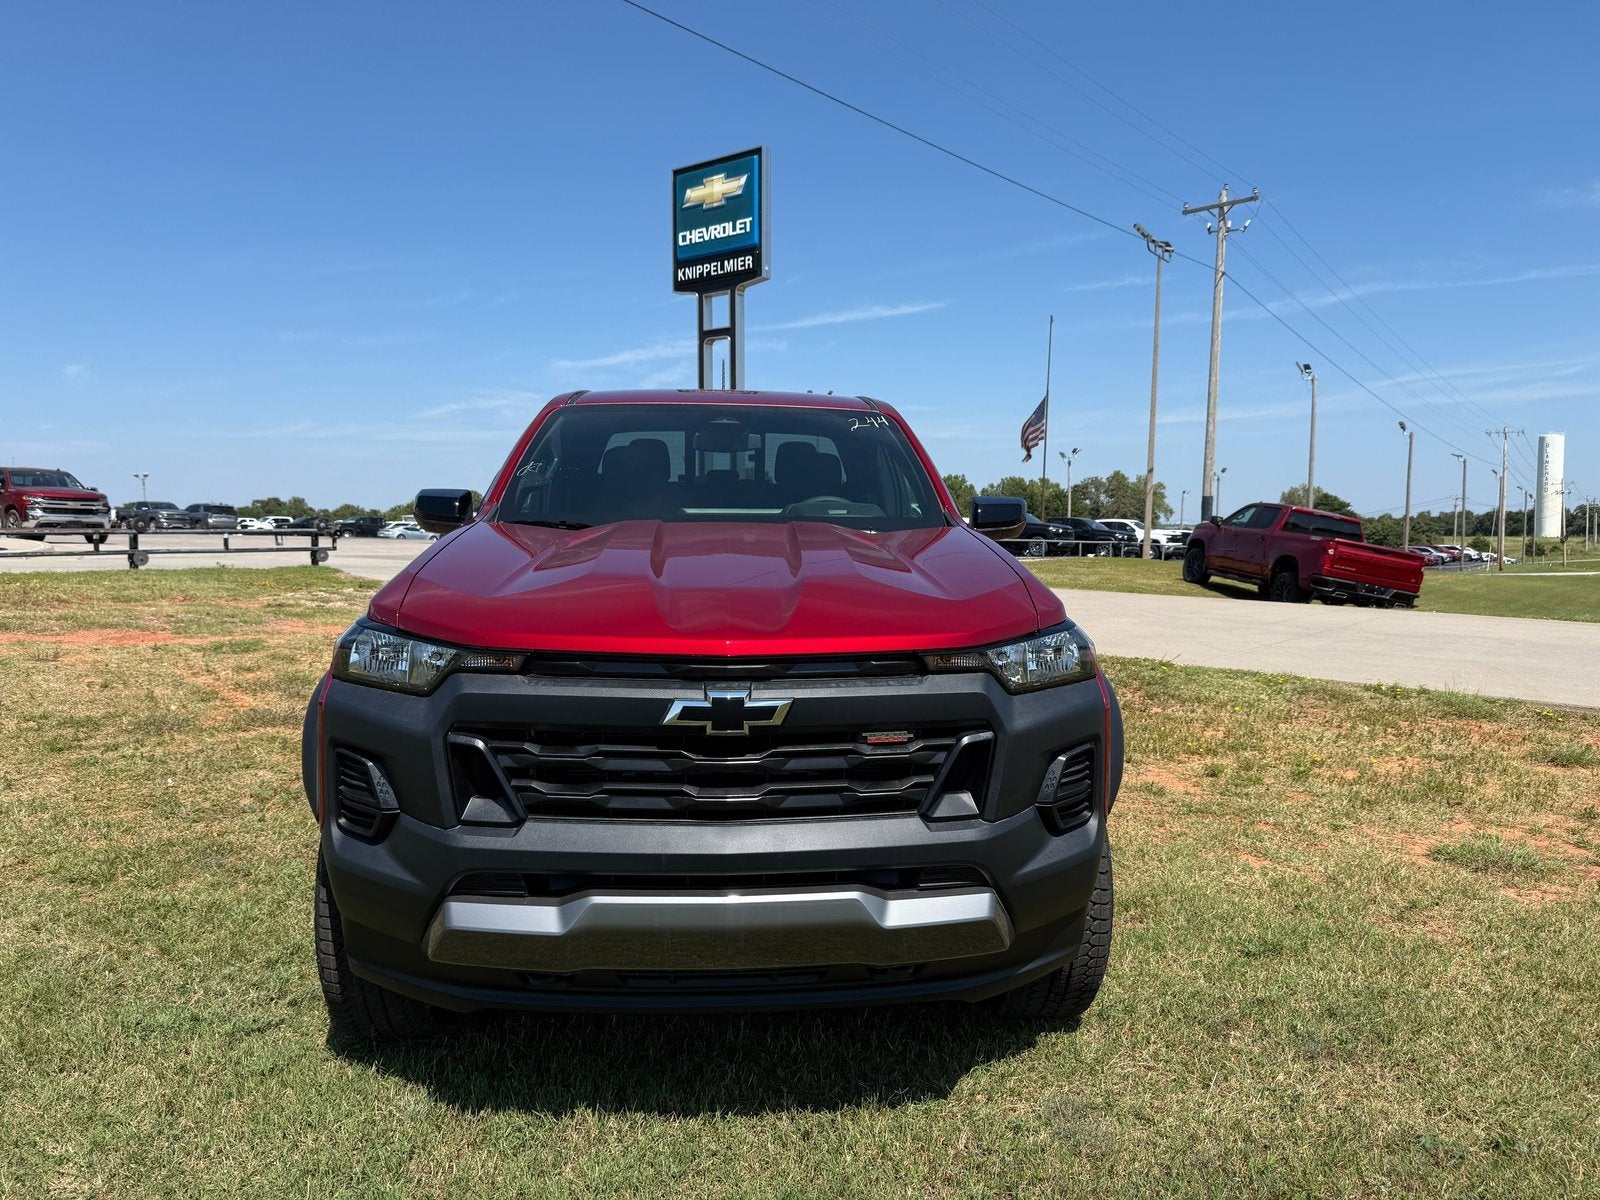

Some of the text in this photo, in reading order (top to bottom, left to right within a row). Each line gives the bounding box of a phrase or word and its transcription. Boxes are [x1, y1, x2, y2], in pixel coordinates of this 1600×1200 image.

[678, 217, 752, 246] CHEVROLET
[678, 255, 753, 282] KNIPPELMIER
[848, 416, 889, 431] 244
